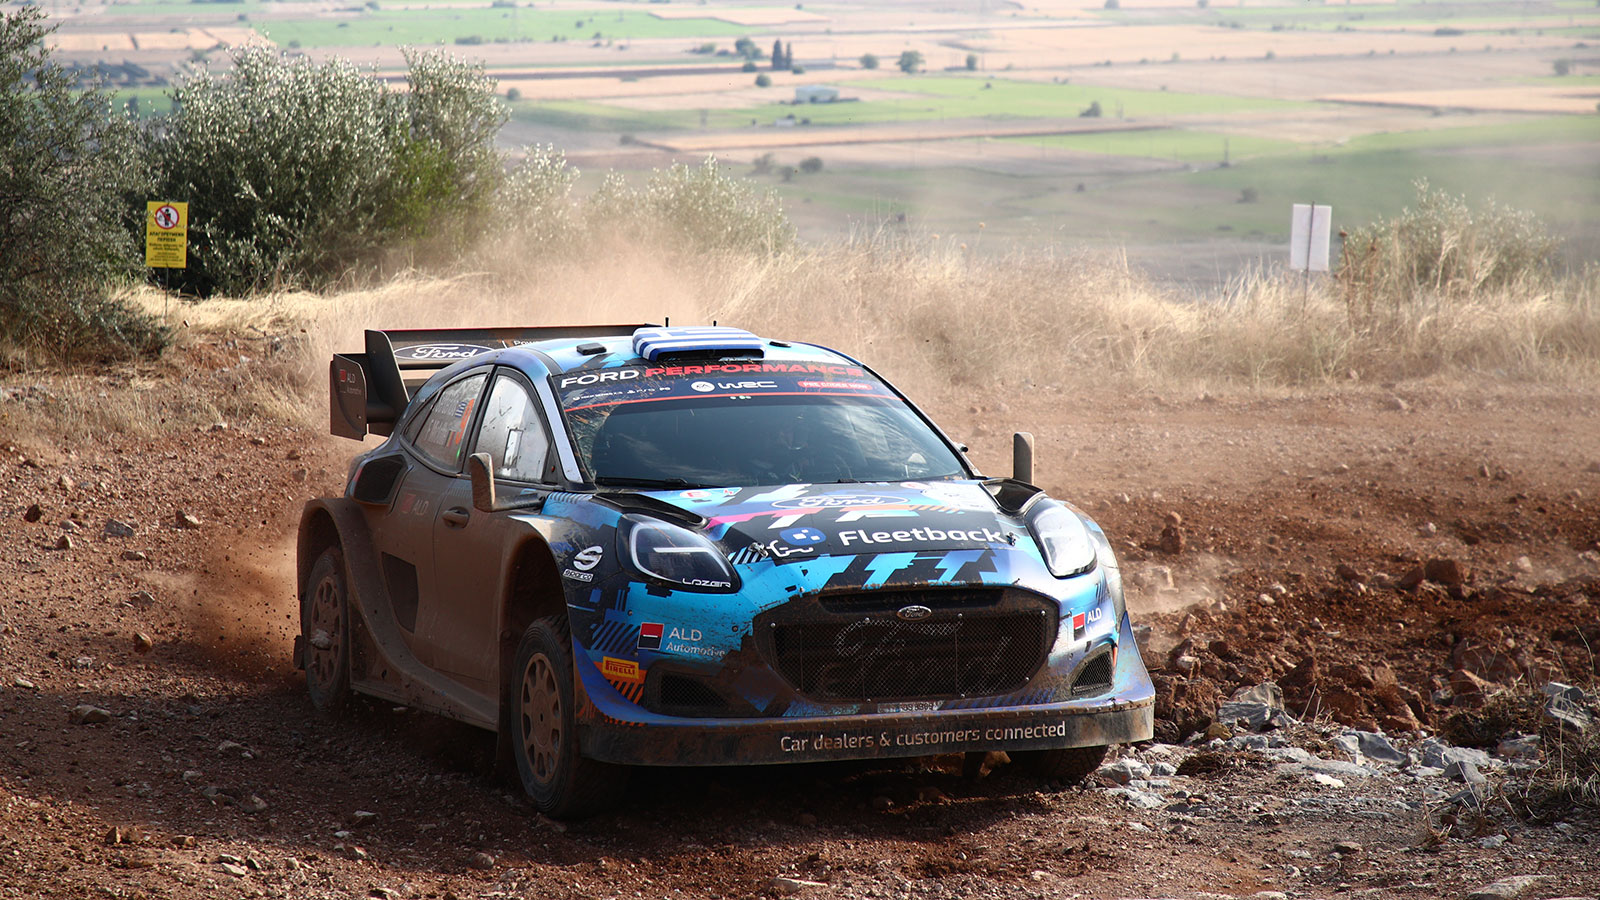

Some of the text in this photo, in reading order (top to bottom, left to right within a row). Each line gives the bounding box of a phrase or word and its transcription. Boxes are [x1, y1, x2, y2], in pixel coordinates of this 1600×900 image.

[412, 346, 477, 358] Ford
[561, 364, 864, 388] FORD PERFORMANCE
[717, 381, 778, 389] WRC
[799, 494, 885, 507] Ford
[838, 526, 1007, 546] Fleetback
[564, 571, 593, 581] sparco
[682, 577, 731, 588] LAZER
[1087, 607, 1102, 624] ALD
[669, 627, 703, 641] ALD
[666, 642, 726, 657] Automotive
[605, 660, 635, 676] PIRELLI
[780, 720, 1066, 752] Car dealers & customers connected
